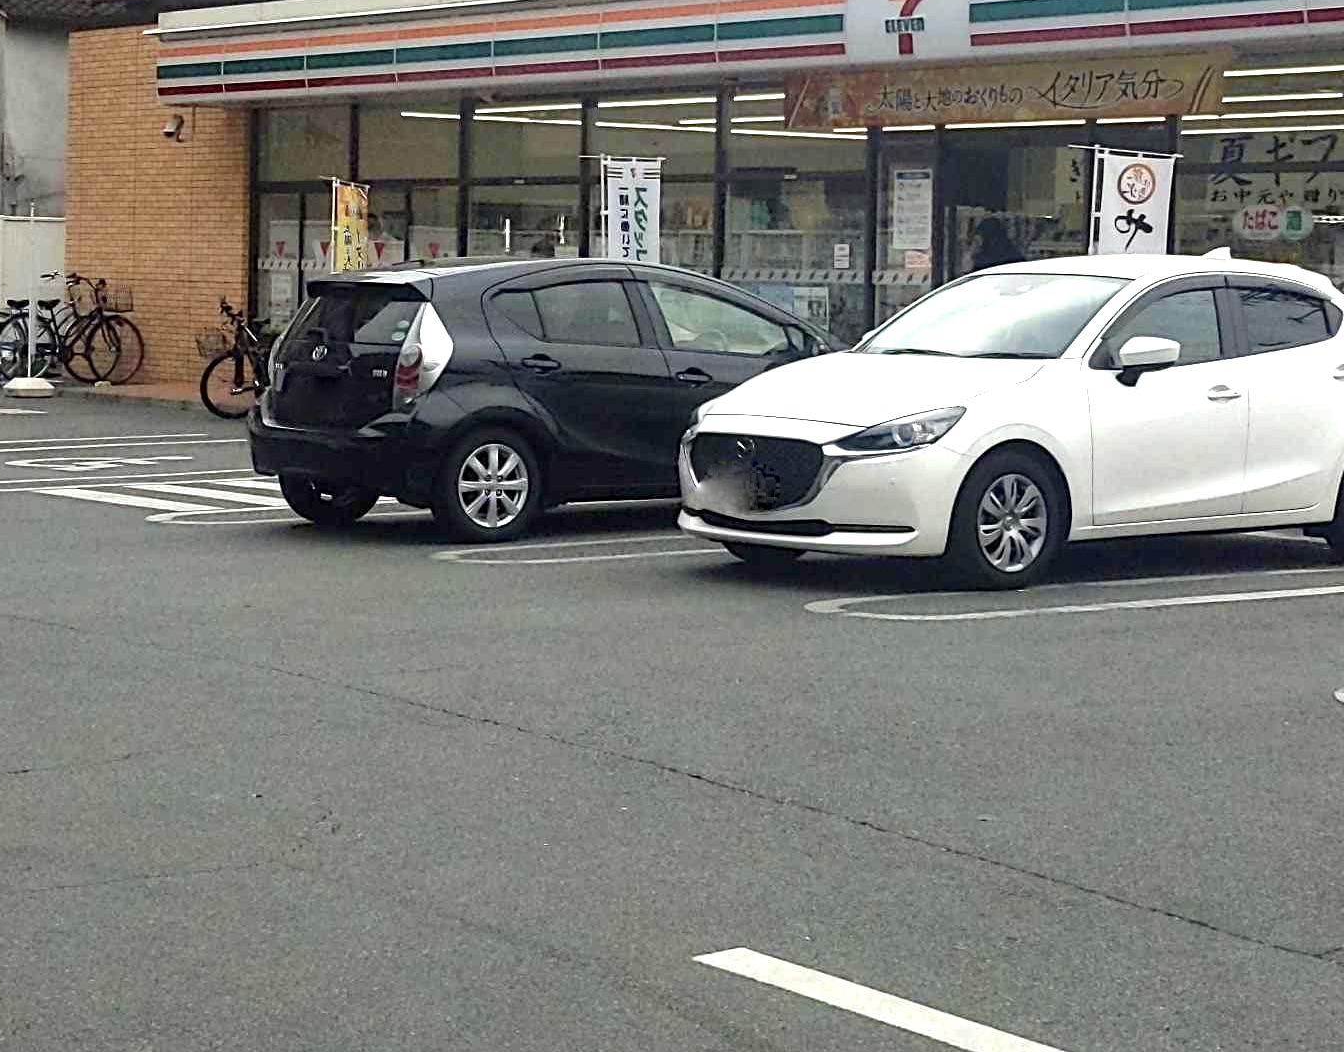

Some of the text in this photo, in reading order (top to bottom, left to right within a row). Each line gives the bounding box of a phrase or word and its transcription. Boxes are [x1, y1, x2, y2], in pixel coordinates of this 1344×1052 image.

[885, 17, 925, 33] ELEVEN
[878, 84, 1024, 111] 太陽と大地のおくりもの
[1042, 68, 1164, 108] イタリア気分
[1242, 210, 1279, 230] たばこ
